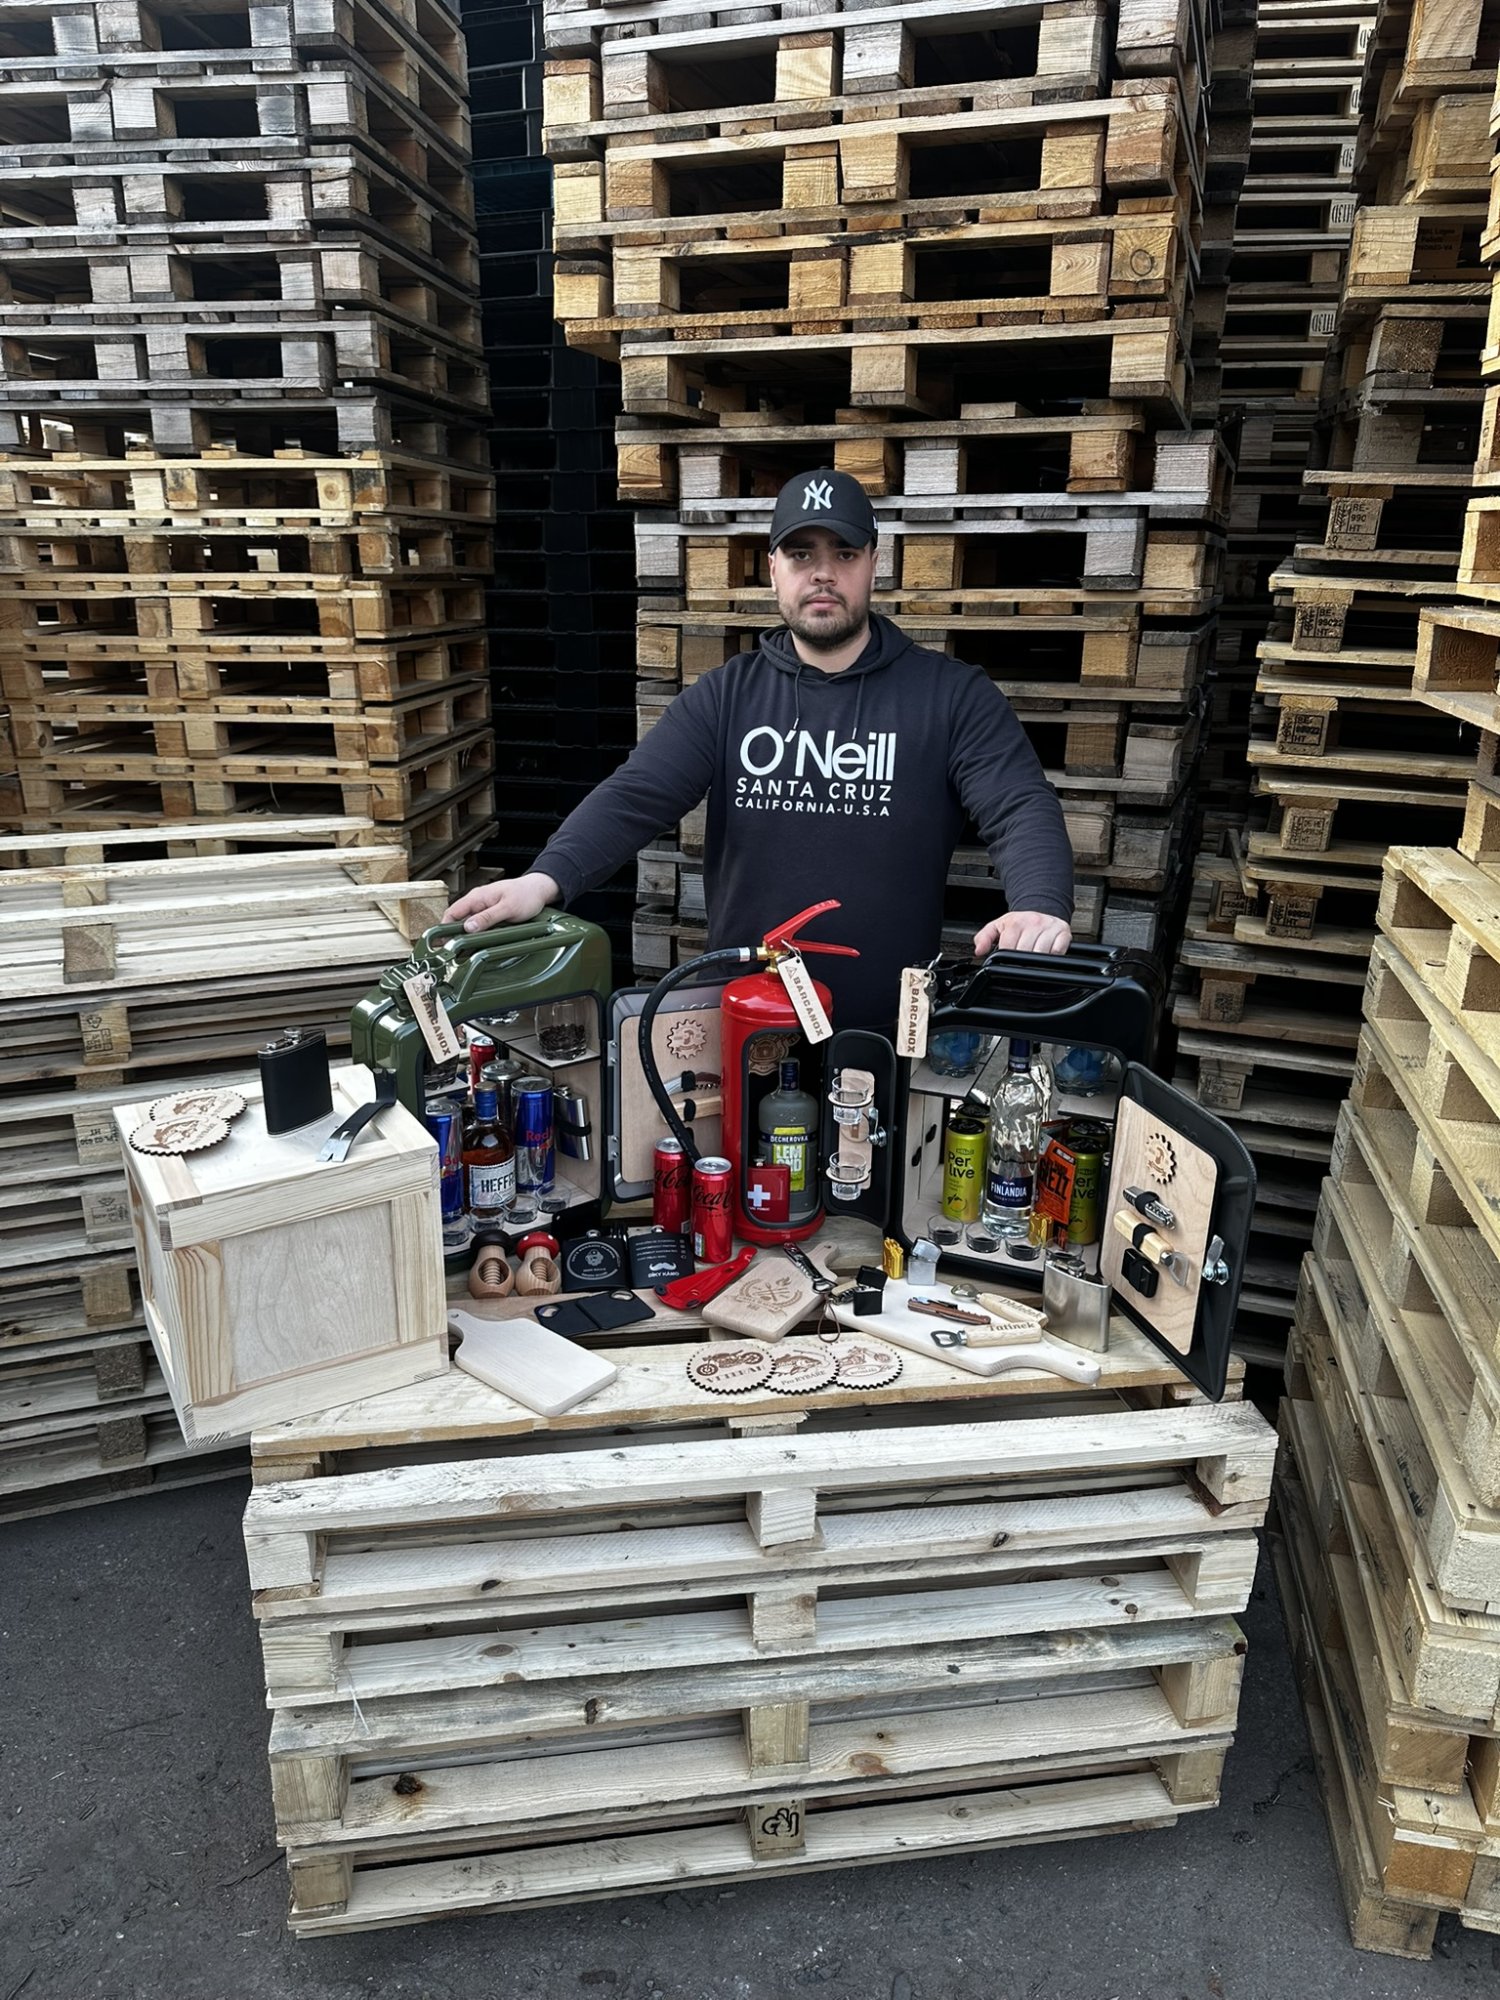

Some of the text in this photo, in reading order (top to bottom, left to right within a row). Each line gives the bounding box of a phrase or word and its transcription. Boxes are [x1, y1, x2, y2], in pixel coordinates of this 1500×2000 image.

[802, 479, 834, 510] NY
[740, 725, 897, 781] O'Neill
[736, 777, 892, 802] SANTA CRUZ
[793, 976, 824, 1037] BARCANOX
[907, 988, 920, 1053] BARCANOX
[991, 1181, 1027, 1198] FINLANDIA
